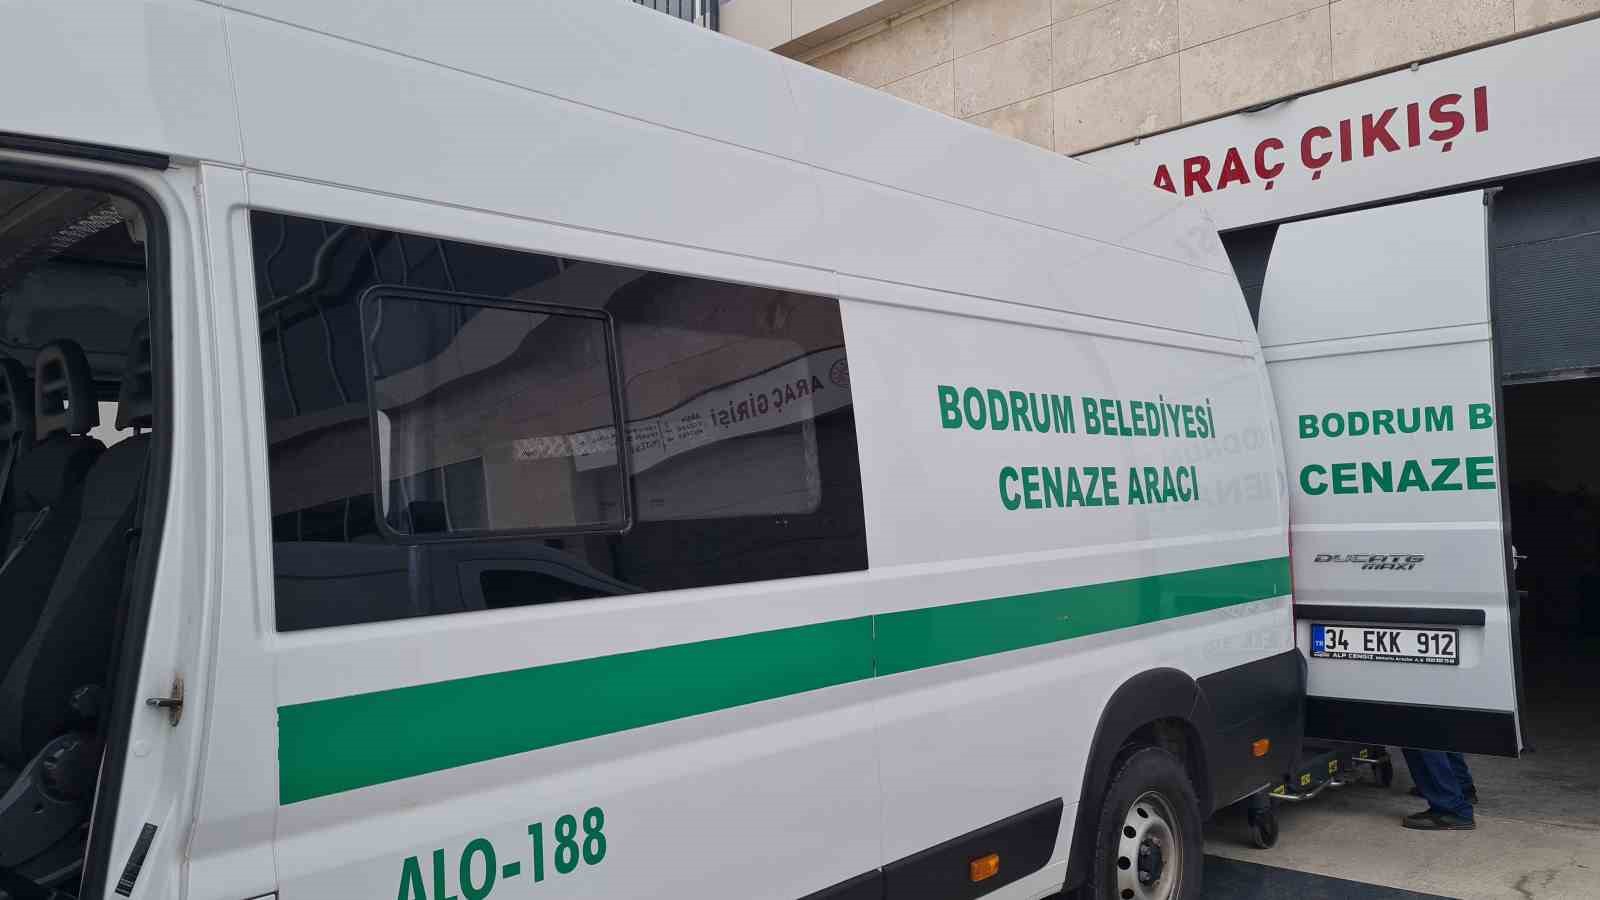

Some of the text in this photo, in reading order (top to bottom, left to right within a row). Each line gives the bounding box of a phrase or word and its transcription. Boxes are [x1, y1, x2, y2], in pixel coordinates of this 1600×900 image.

[1153, 85, 1489, 197] ARAÇ ÇIKIŞI
[937, 384, 1077, 434] BODRUM
[1081, 393, 1217, 440] BELEDİYESİ
[1297, 403, 1455, 440] BODRUM
[1467, 402, 1495, 432] B
[998, 465, 1120, 512] CENAZE
[1127, 464, 1202, 505] ARACI
[1299, 454, 1497, 497] CENAZE
[1313, 553, 1425, 564] DUCATO
[1361, 562, 1416, 571] MAXI
[1325, 629, 1454, 656] 34 EKK 912
[396, 806, 608, 900] ALO-188
